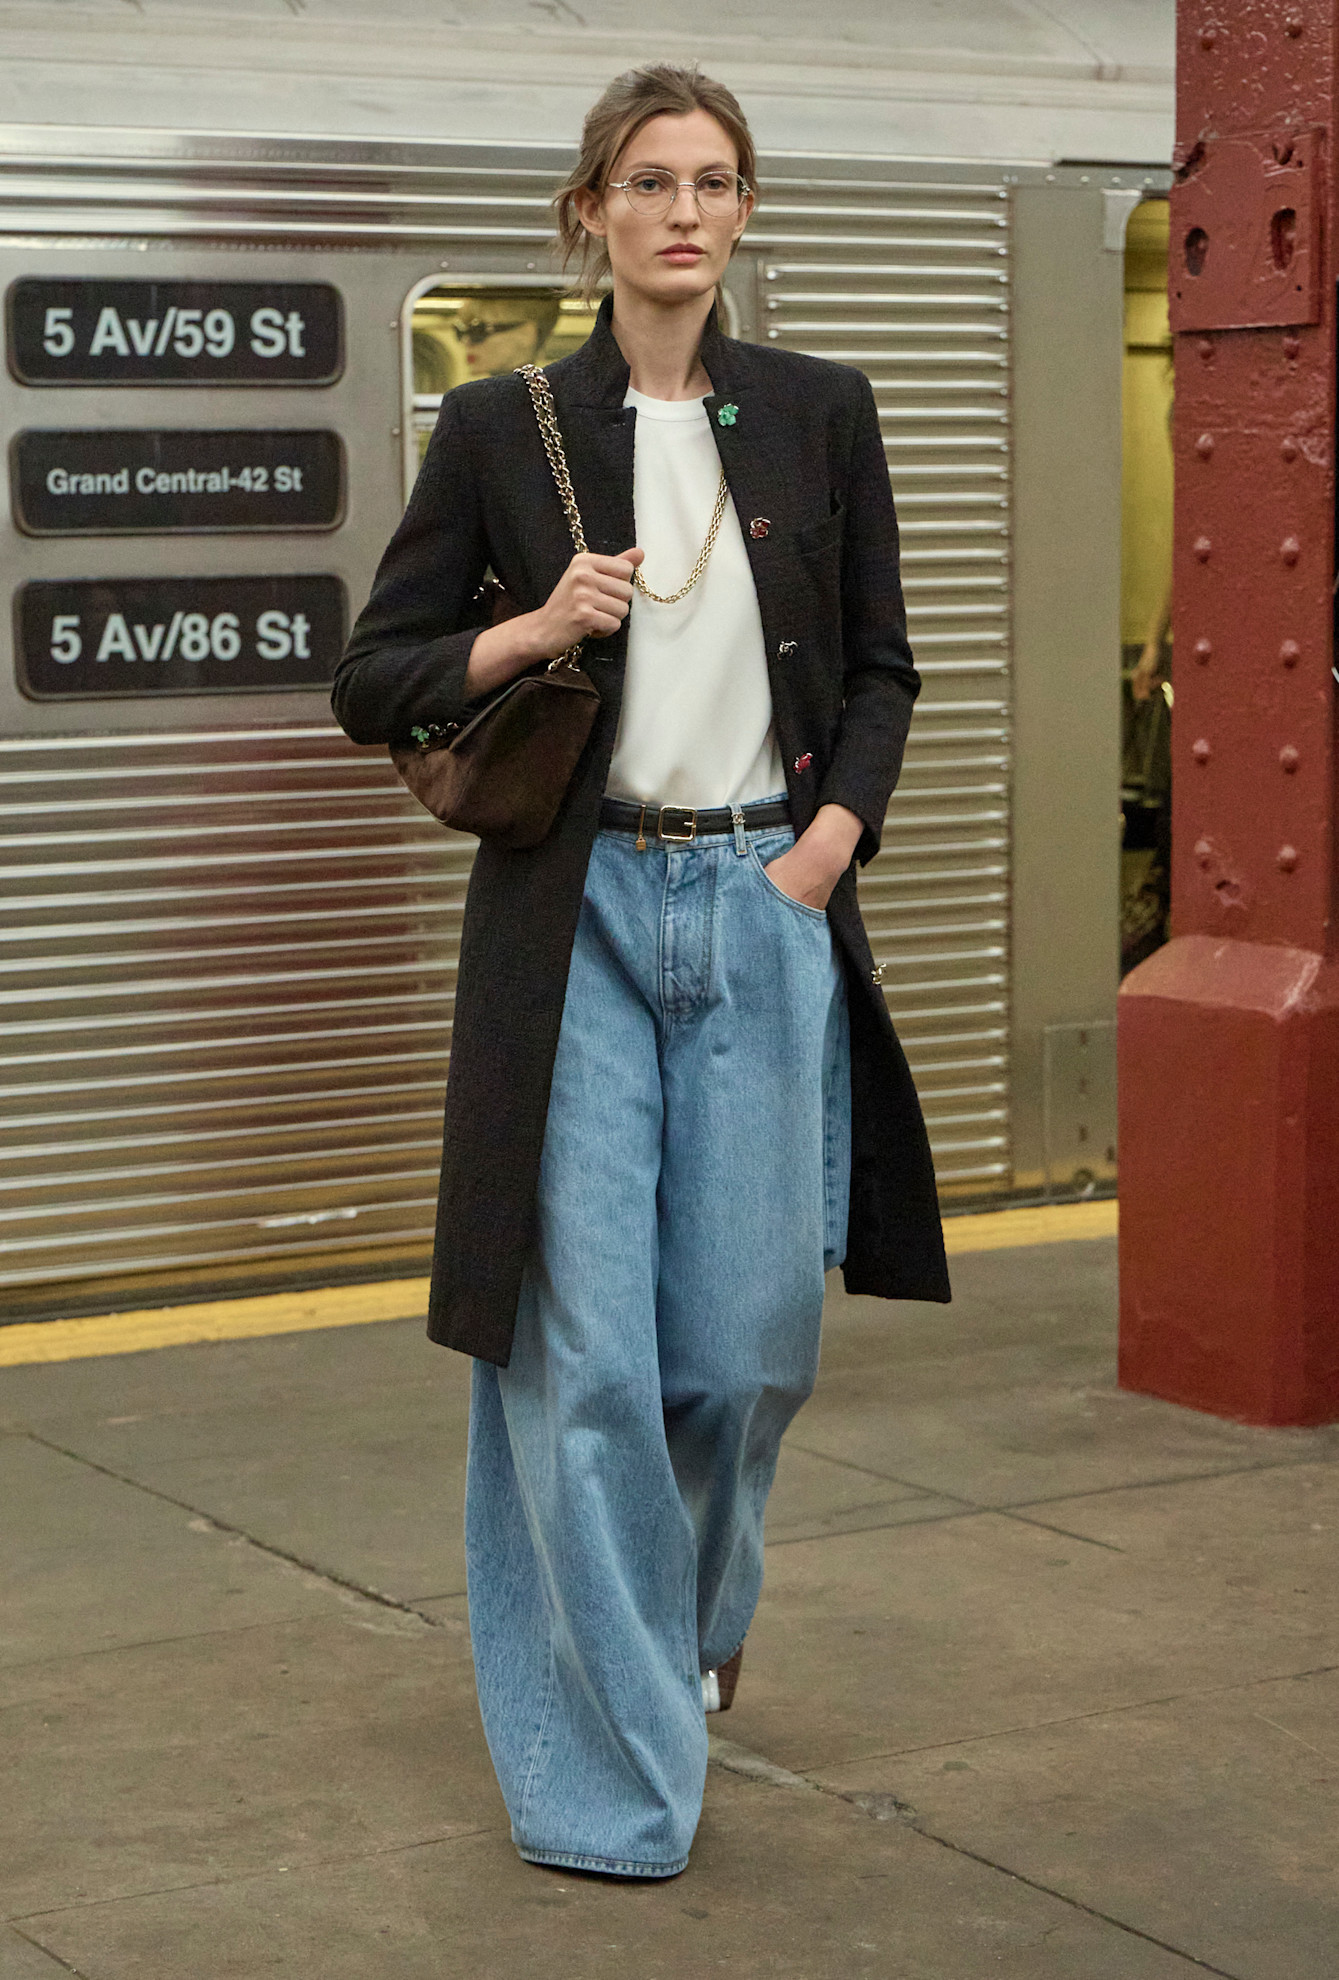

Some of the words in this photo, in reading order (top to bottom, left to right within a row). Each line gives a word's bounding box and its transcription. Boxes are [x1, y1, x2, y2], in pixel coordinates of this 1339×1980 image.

[44, 308, 74, 356] 5
[90, 307, 234, 357] Av/59
[251, 308, 306, 357] St
[47, 469, 129, 494] Grand
[136, 467, 268, 493] Central-42
[275, 466, 303, 491] St
[51, 616, 81, 663] 5
[97, 612, 240, 661] Av/86
[257, 611, 311, 659] St
